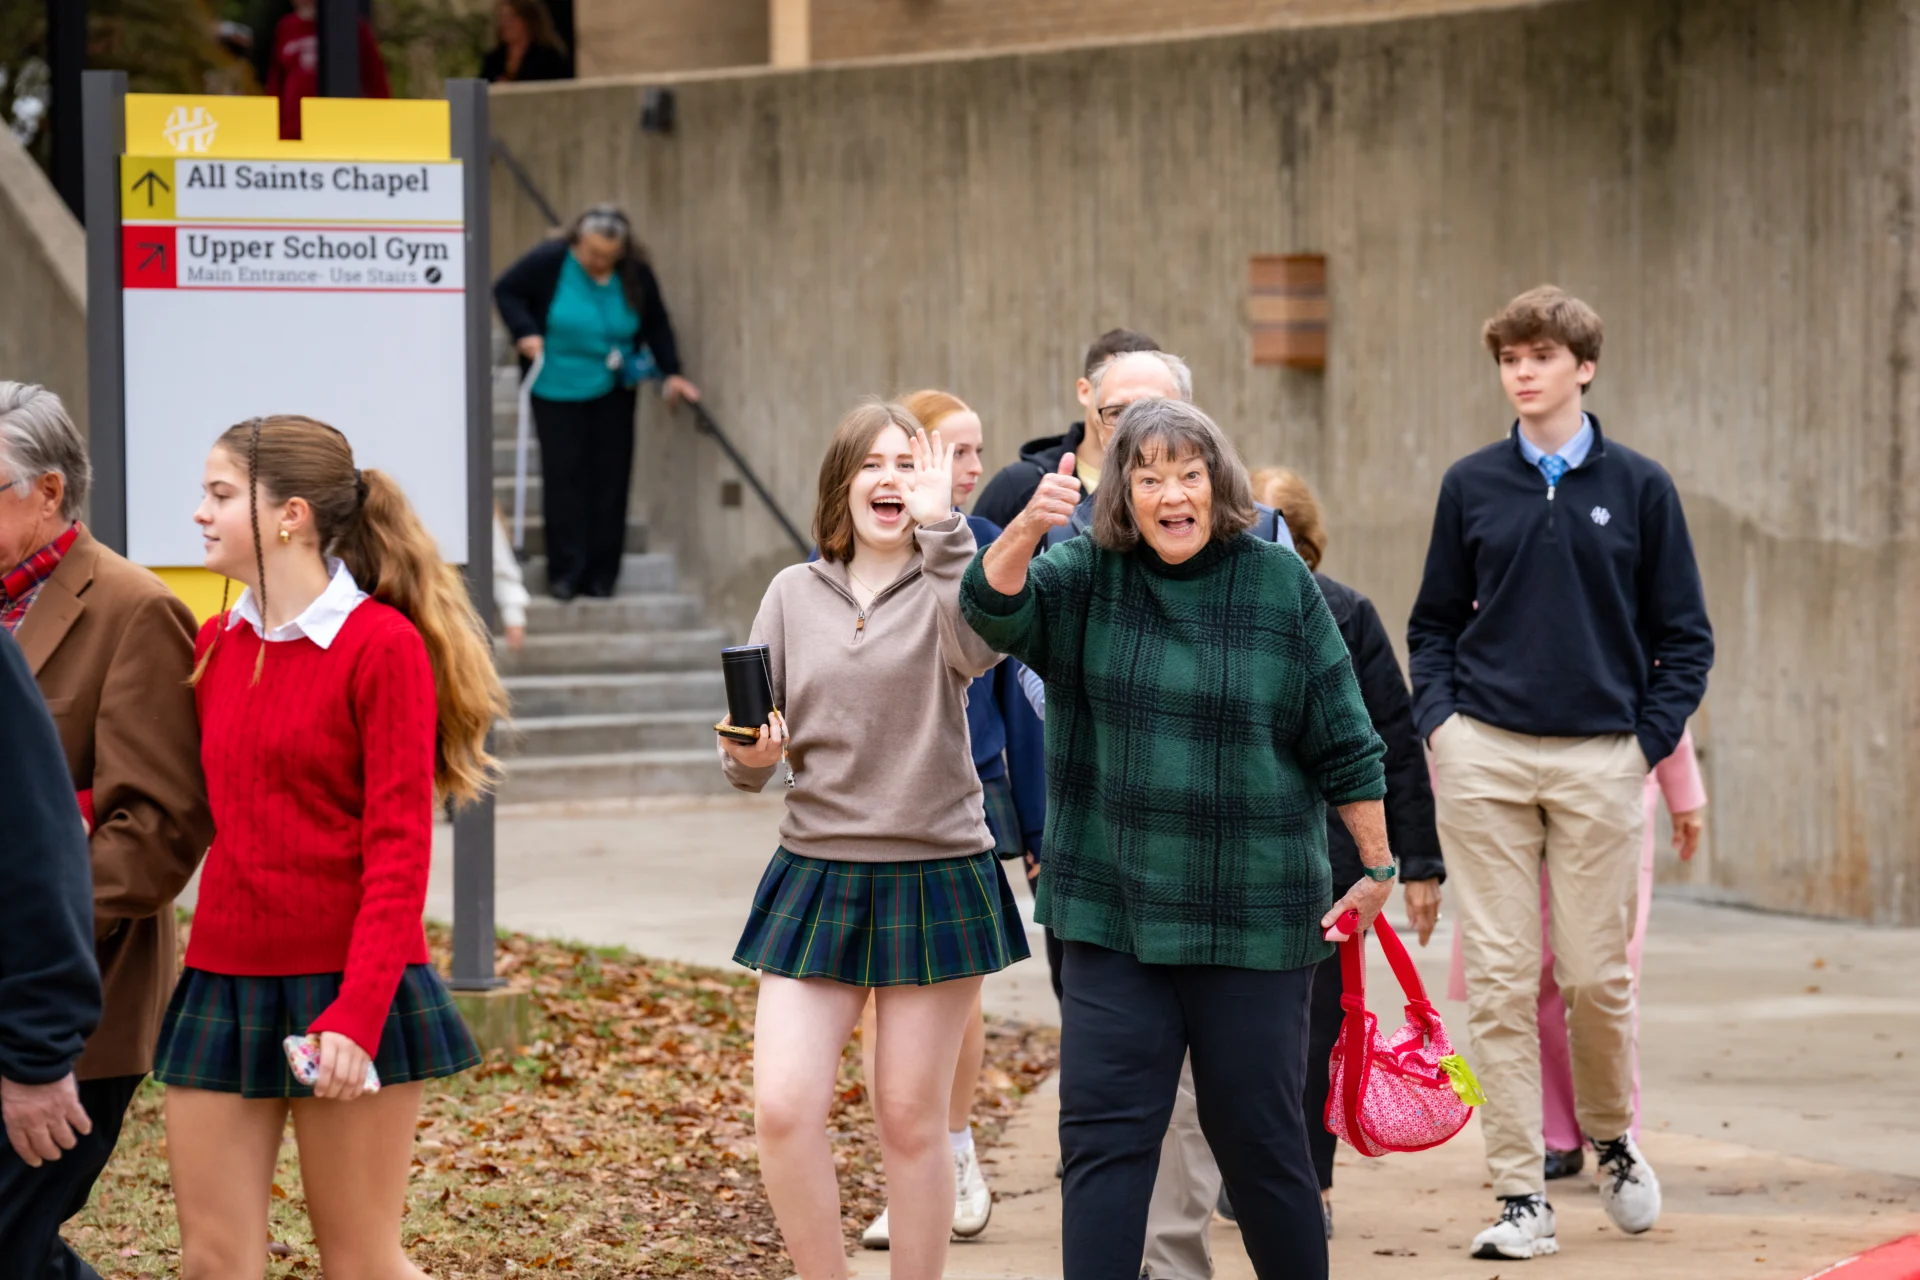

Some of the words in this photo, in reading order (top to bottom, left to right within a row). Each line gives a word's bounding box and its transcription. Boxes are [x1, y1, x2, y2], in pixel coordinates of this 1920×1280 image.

[186, 163, 227, 190] All
[235, 164, 325, 191] Saints
[332, 166, 429, 198] Chapel
[187, 234, 275, 264] Upper
[283, 235, 378, 260] School
[385, 237, 449, 265] Gym
[187, 266, 232, 283] Main
[329, 268, 363, 284] Use
[366, 267, 419, 285] Stairs
